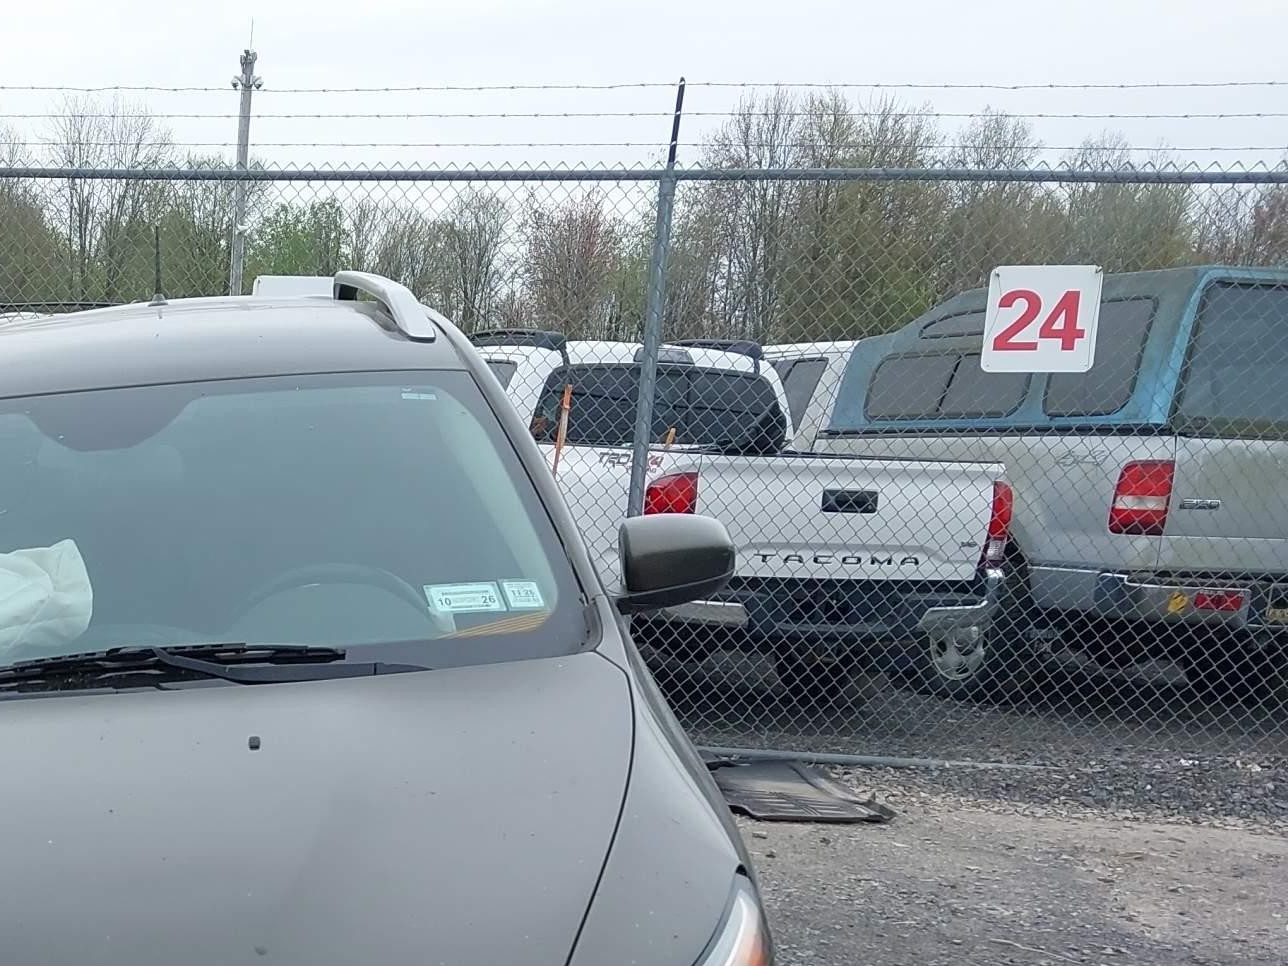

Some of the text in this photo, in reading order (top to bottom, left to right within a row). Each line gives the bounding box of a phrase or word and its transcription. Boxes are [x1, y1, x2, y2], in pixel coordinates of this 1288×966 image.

[992, 289, 1086, 352] 24
[754, 552, 920, 566] TACOMA
[438, 596, 452, 606] 10
[481, 595, 496, 604] 26
